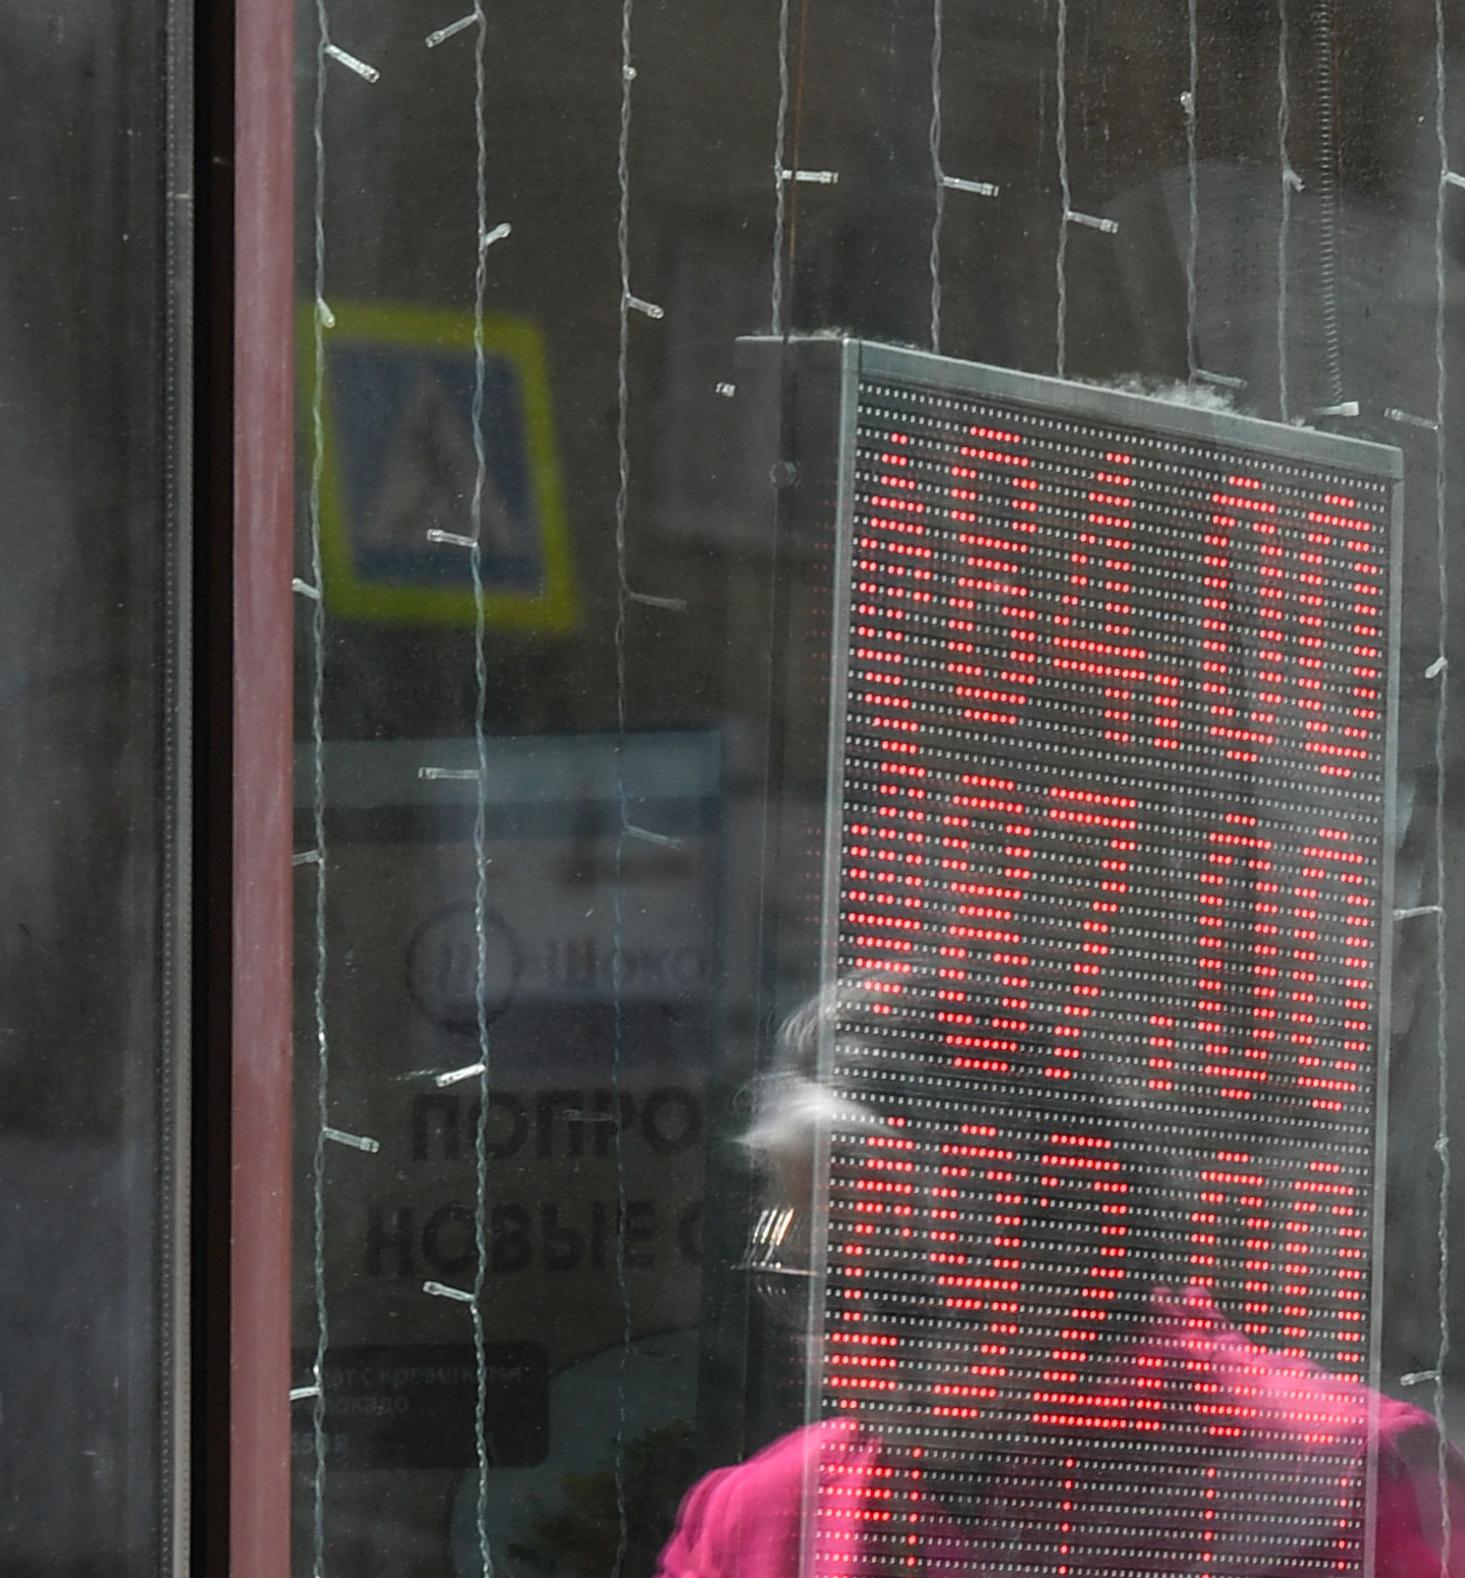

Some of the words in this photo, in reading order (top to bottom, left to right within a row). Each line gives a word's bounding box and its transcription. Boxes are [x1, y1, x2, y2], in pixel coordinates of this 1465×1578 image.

[947, 422, 1380, 781] 84.00
[935, 769, 1369, 1114] 87.00
[365, 1200, 656, 1277] НОВЫЕ
